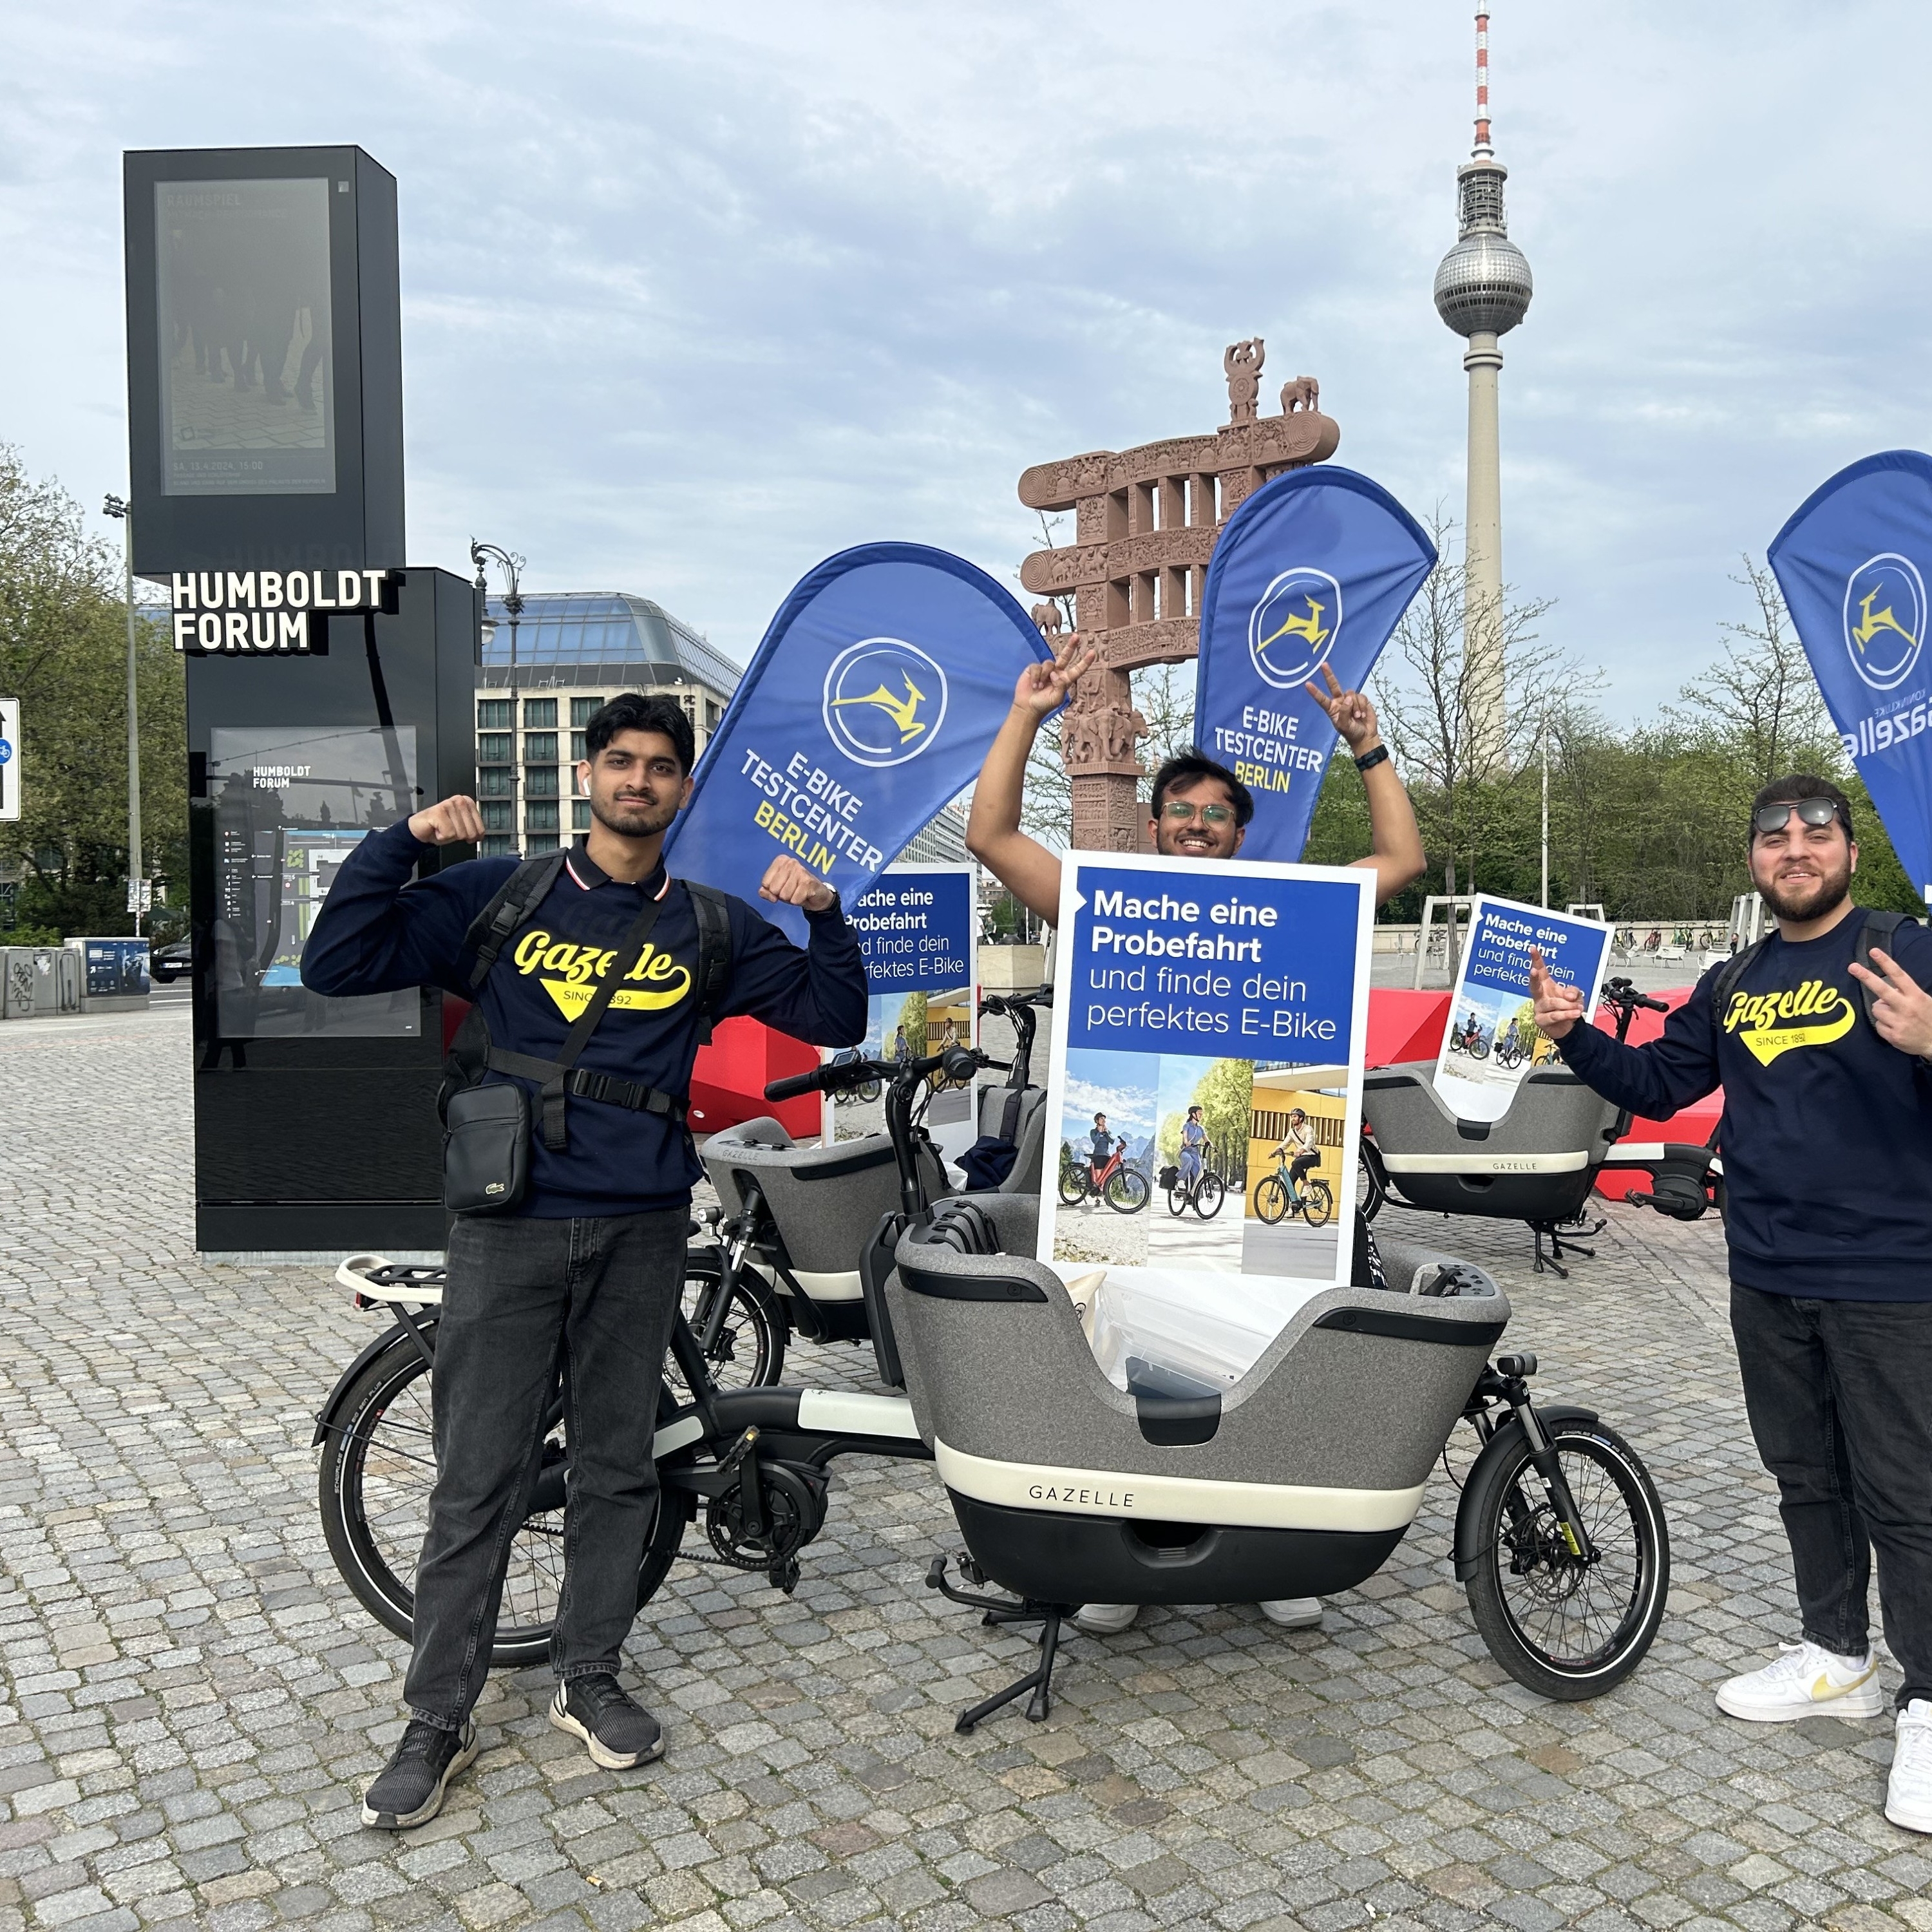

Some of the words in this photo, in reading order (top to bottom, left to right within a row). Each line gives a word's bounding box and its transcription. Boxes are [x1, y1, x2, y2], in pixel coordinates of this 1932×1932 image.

[167, 193, 242, 207] RAUMSPIEL
[173, 462, 187, 471] SA.
[173, 570, 386, 609] HUMBOLDT
[174, 611, 308, 650] FORUM
[1242, 706, 1299, 741] E-BIKE
[1215, 726, 1323, 773] TESTCENTER
[253, 766, 310, 777] HUMBOLDT
[253, 778, 290, 788] FORUM
[786, 751, 863, 822] E-BIKE
[1235, 761, 1291, 794] BERLIN
[740, 748, 884, 873] TESTCENTER
[753, 800, 837, 875] BERLIN
[857, 889, 896, 907] ache
[900, 887, 934, 906] eine
[1093, 889, 1200, 923] Mache
[1209, 897, 1278, 927] eine
[876, 936, 914, 954] finde
[919, 935, 949, 952] dein
[1091, 926, 1262, 963] Probefahrt
[1485, 913, 1533, 936] Mache
[1536, 927, 1567, 944] eine
[514, 930, 673, 983] Gazele
[919, 957, 964, 976] E-Bike
[1478, 948, 1504, 962] und
[1507, 952, 1532, 970] find
[1546, 963, 1575, 980] dein
[1090, 965, 1146, 992] und
[1157, 967, 1231, 998] finde
[1242, 973, 1306, 1002] dein
[1473, 963, 1530, 987] perfekte
[564, 990, 594, 1002] SINC
[609, 995, 632, 1005] 892
[1723, 980, 1839, 1034] Gazelle
[1086, 1002, 1229, 1034] perfektes
[1241, 1009, 1336, 1041] E-Bike
[1756, 1036, 1788, 1046] SINCE
[723, 1150, 761, 1160] GAZELLE
[1493, 1162, 1538, 1170] GAZELLE
[334, 1453, 343, 1494] SCHWALBE
[368, 1381, 382, 1397] PLUS
[1029, 1485, 1135, 1508] GAZELLE
